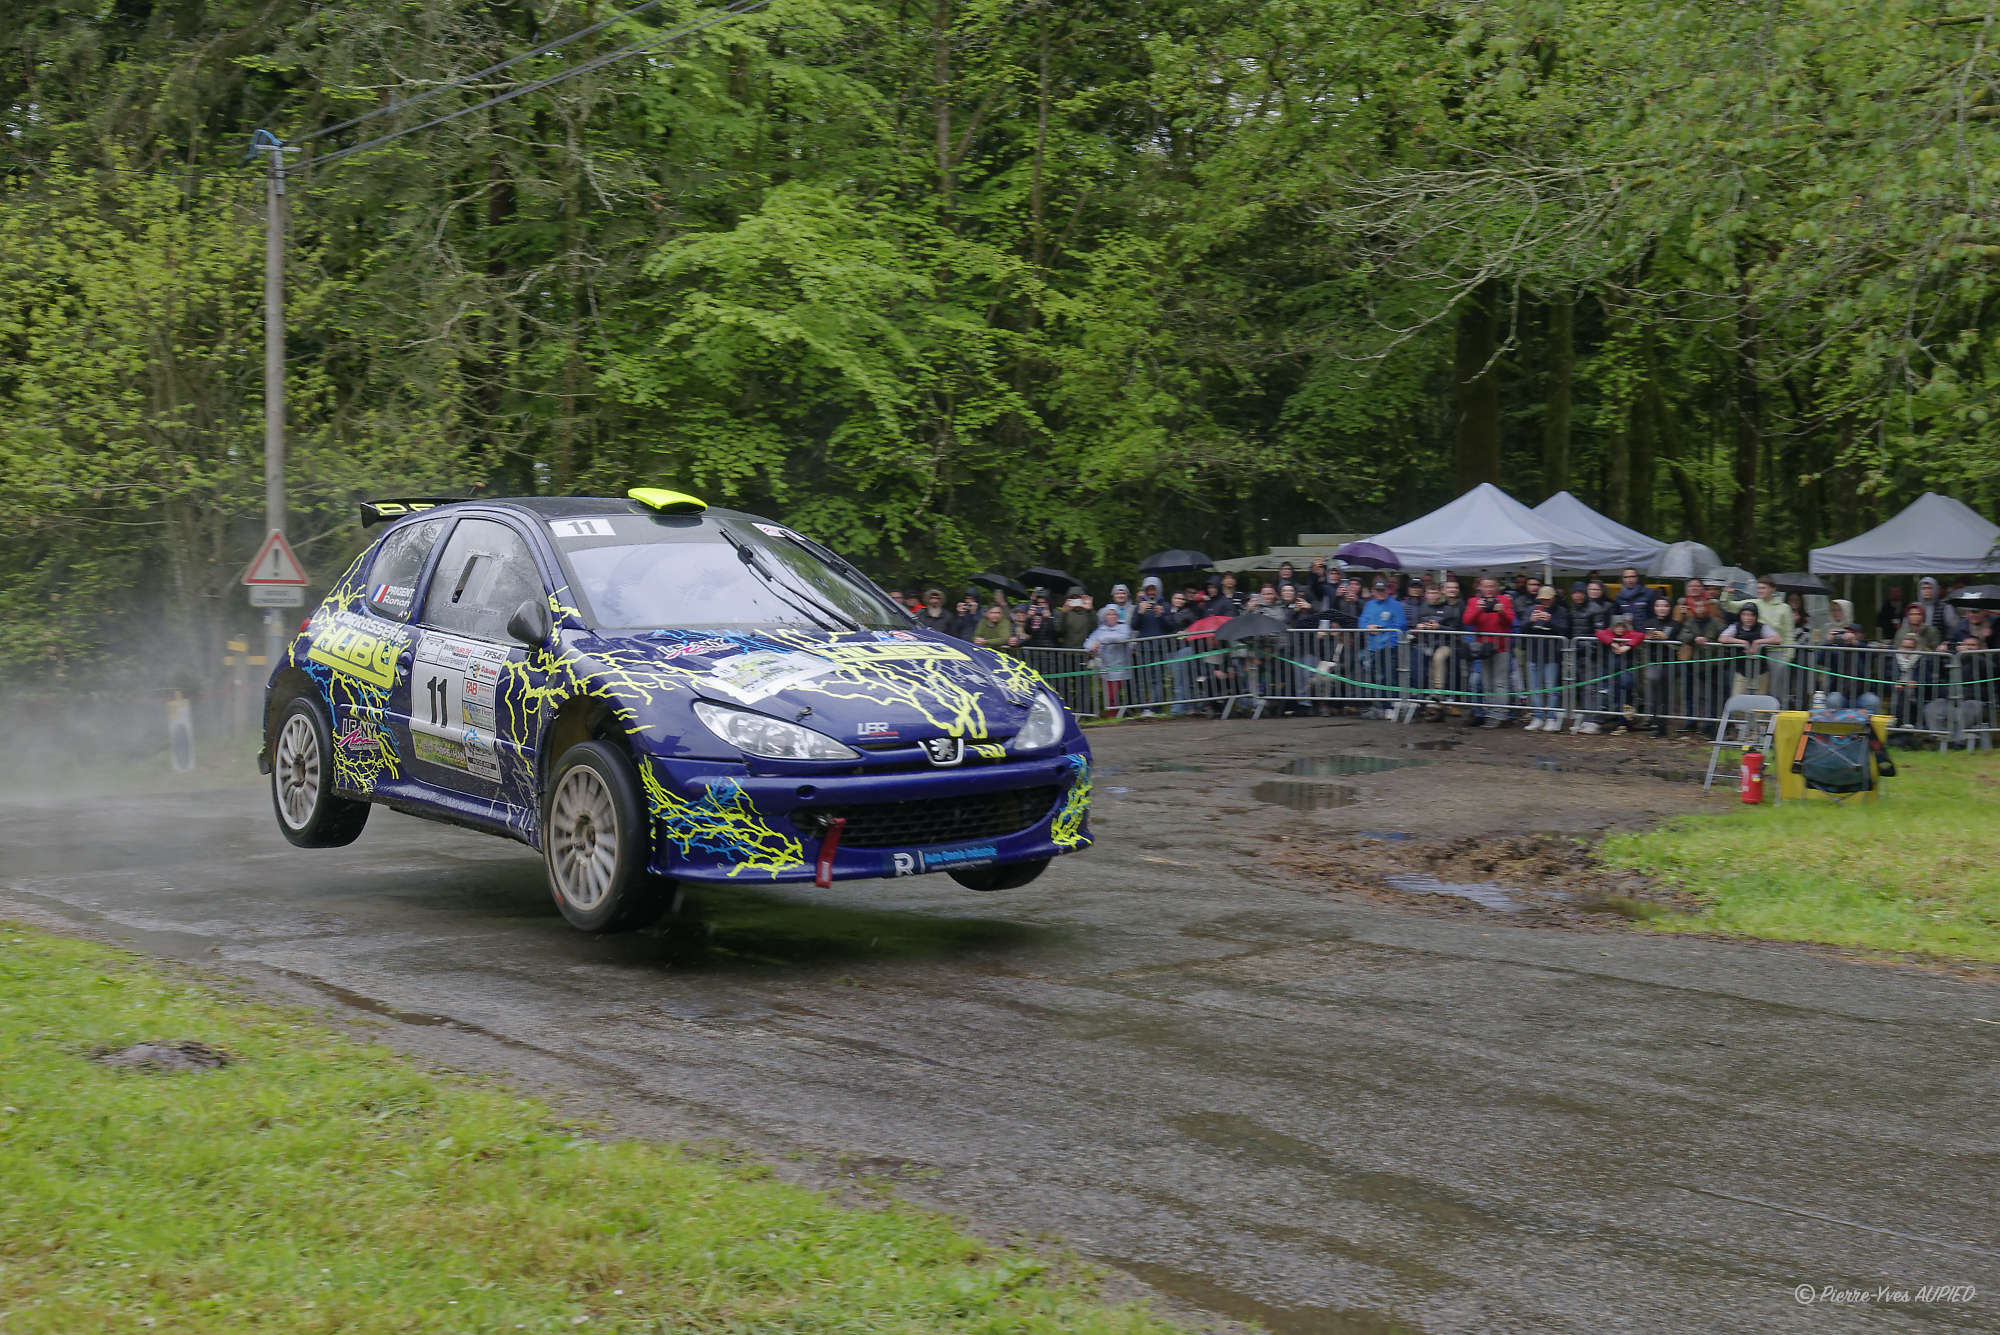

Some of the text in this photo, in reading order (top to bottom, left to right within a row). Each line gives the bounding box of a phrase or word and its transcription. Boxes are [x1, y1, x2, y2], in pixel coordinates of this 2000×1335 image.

[568, 520, 598, 535] 11
[382, 595, 410, 607] Ronan
[427, 676, 448, 729] 11
